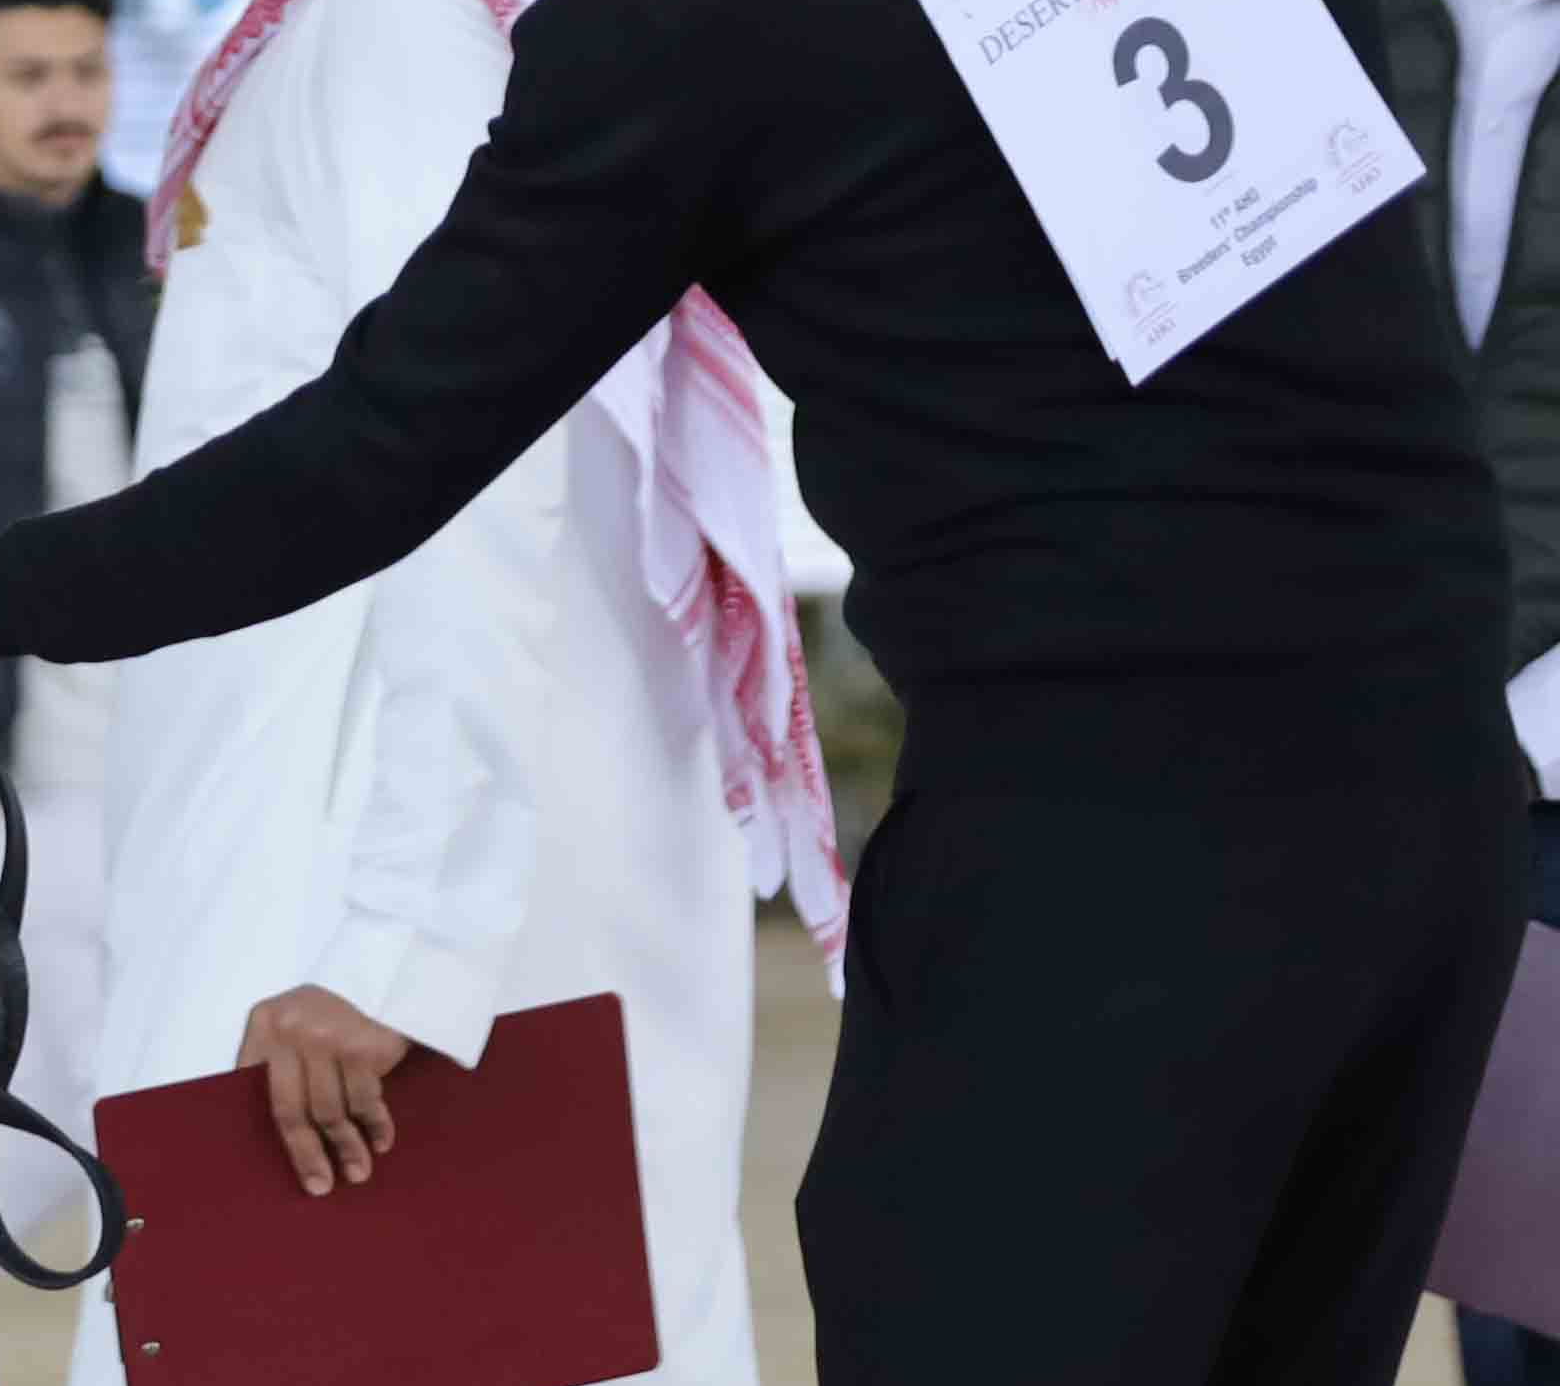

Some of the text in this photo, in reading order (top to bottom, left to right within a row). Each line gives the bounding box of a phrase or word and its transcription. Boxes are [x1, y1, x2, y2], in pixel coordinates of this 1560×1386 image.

[1112, 16, 1235, 183] 3
[1233, 177, 1319, 242] Championship
[1240, 234, 1278, 267] Egypt
